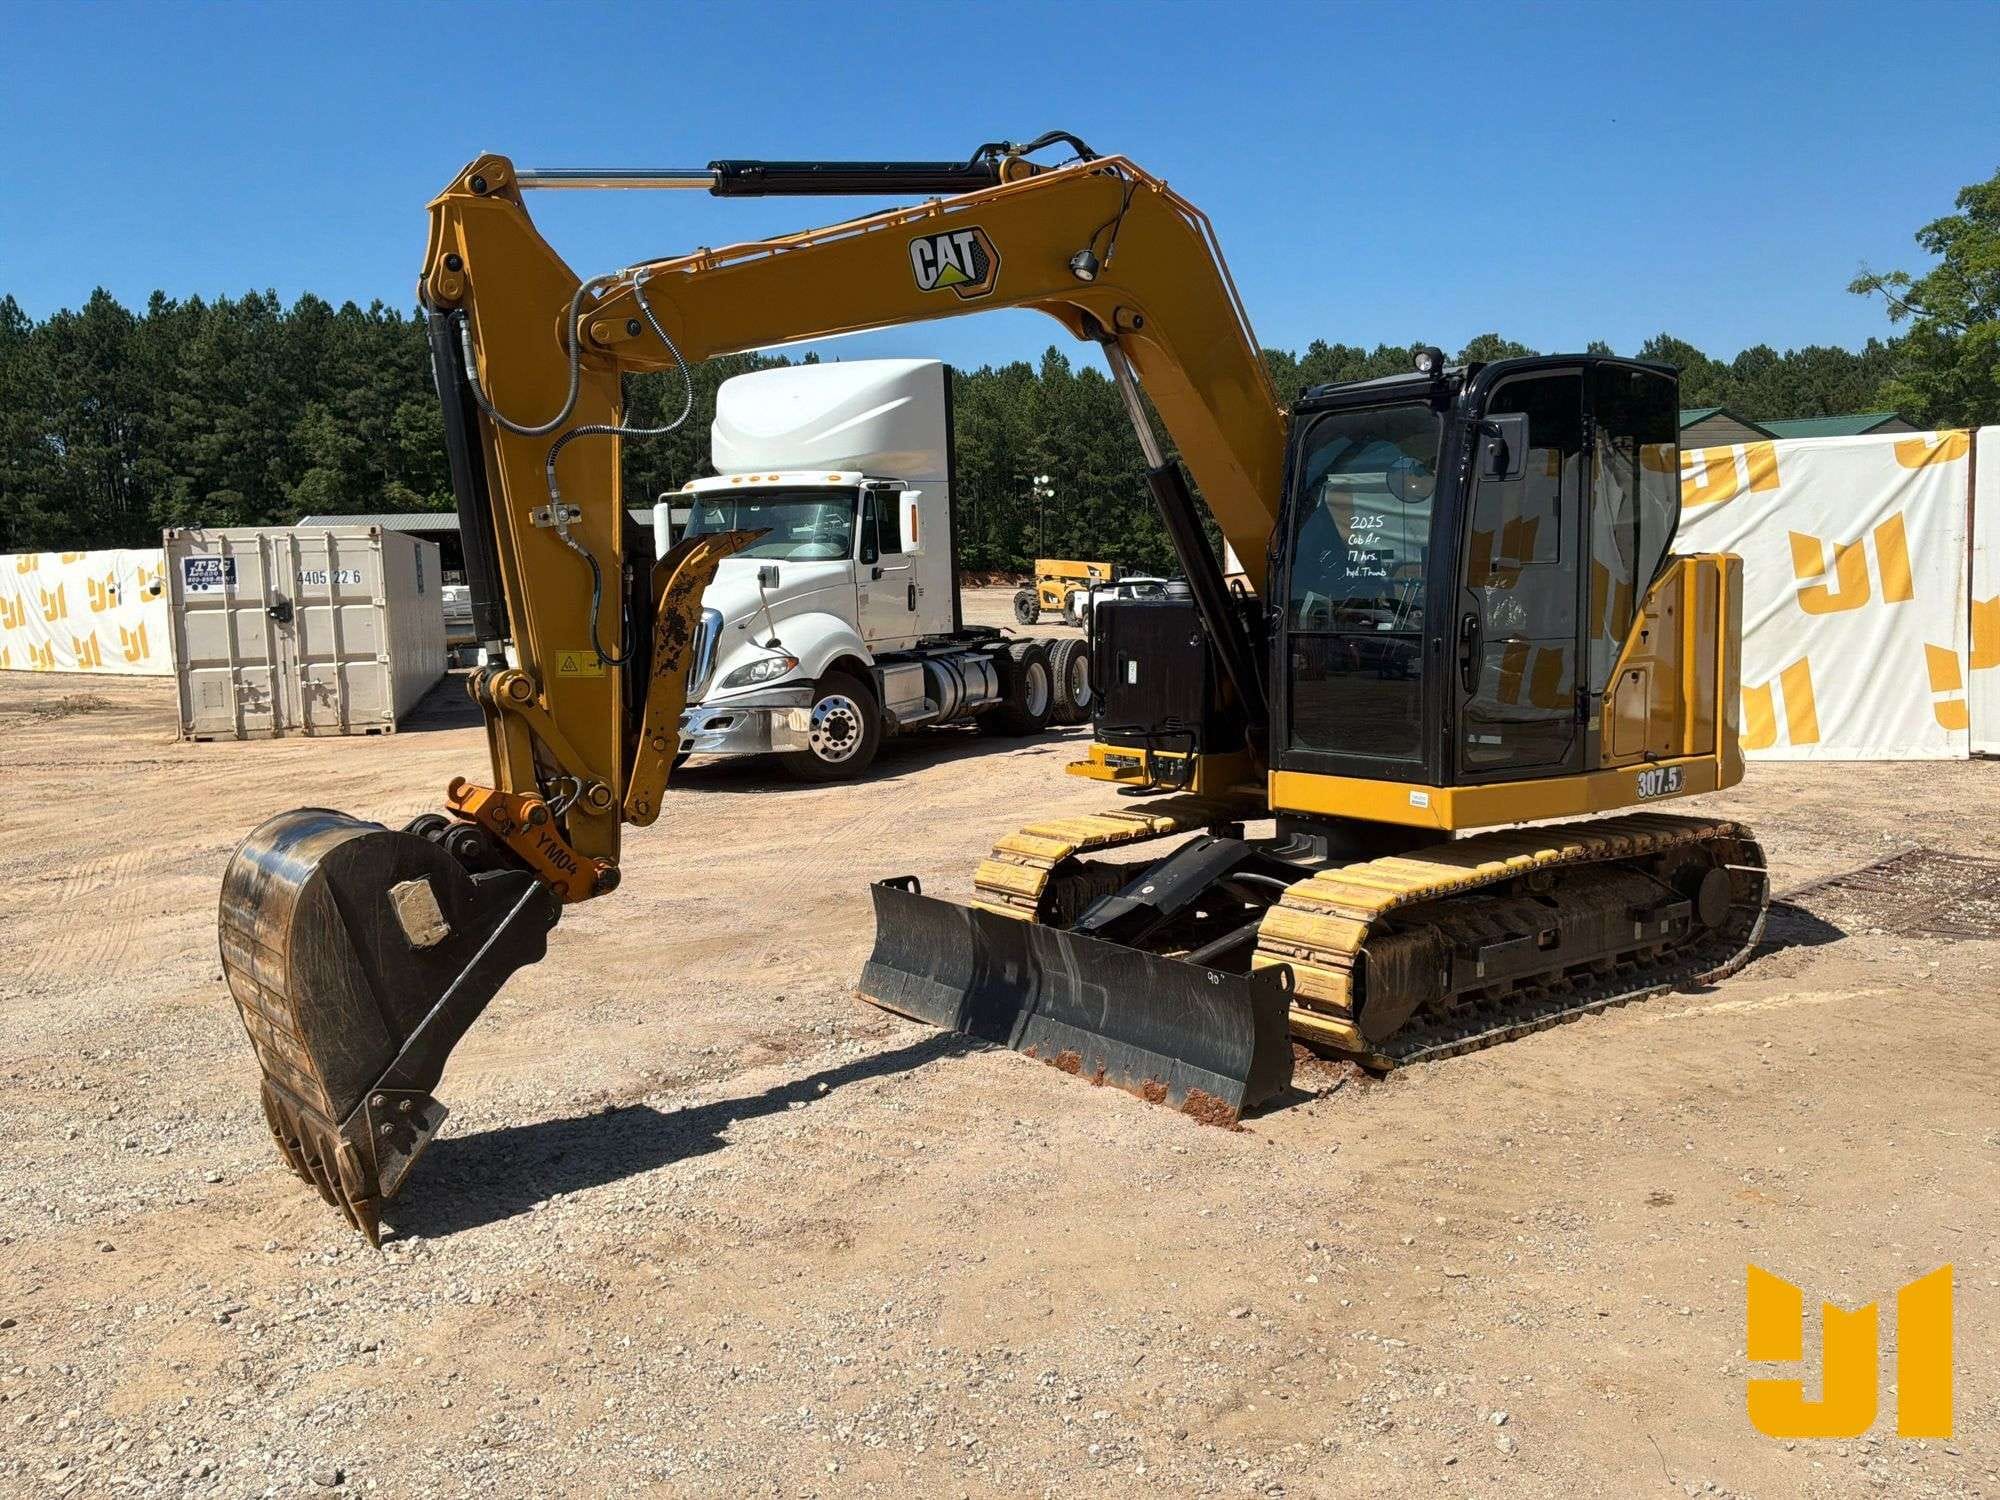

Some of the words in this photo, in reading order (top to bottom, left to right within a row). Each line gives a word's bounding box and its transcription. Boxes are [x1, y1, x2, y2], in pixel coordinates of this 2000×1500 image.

[910, 231, 976, 290] CAT
[1350, 514, 1385, 529] 2025
[1347, 550, 1358, 562] 17
[353, 570, 361, 584] 6
[1637, 766, 1679, 798] 307.5
[536, 832, 577, 876] YM04
